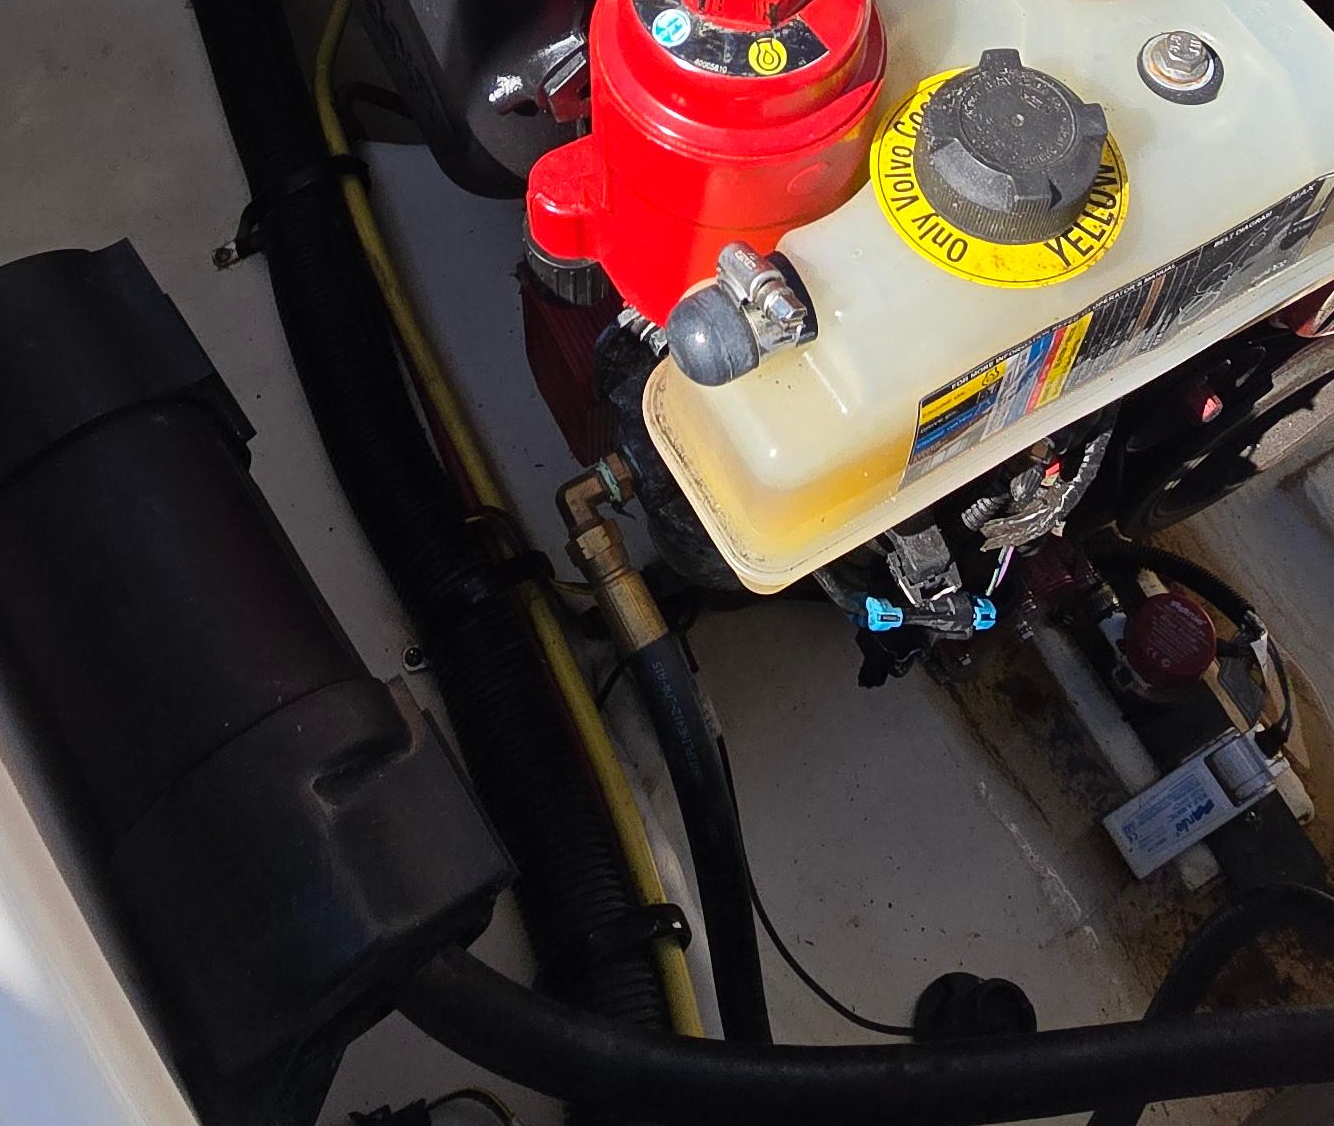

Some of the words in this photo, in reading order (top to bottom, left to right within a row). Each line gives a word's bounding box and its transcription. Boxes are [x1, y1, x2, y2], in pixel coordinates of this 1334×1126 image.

[884, 145, 920, 211] Volvo
[911, 212, 969, 263] Only
[1044, 164, 1119, 268] YELLOW
[1213, 233, 1235, 248] BELT
[1235, 210, 1273, 238] DIAGRAM
[951, 375, 969, 390] FOR
[970, 360, 995, 379] MORE
